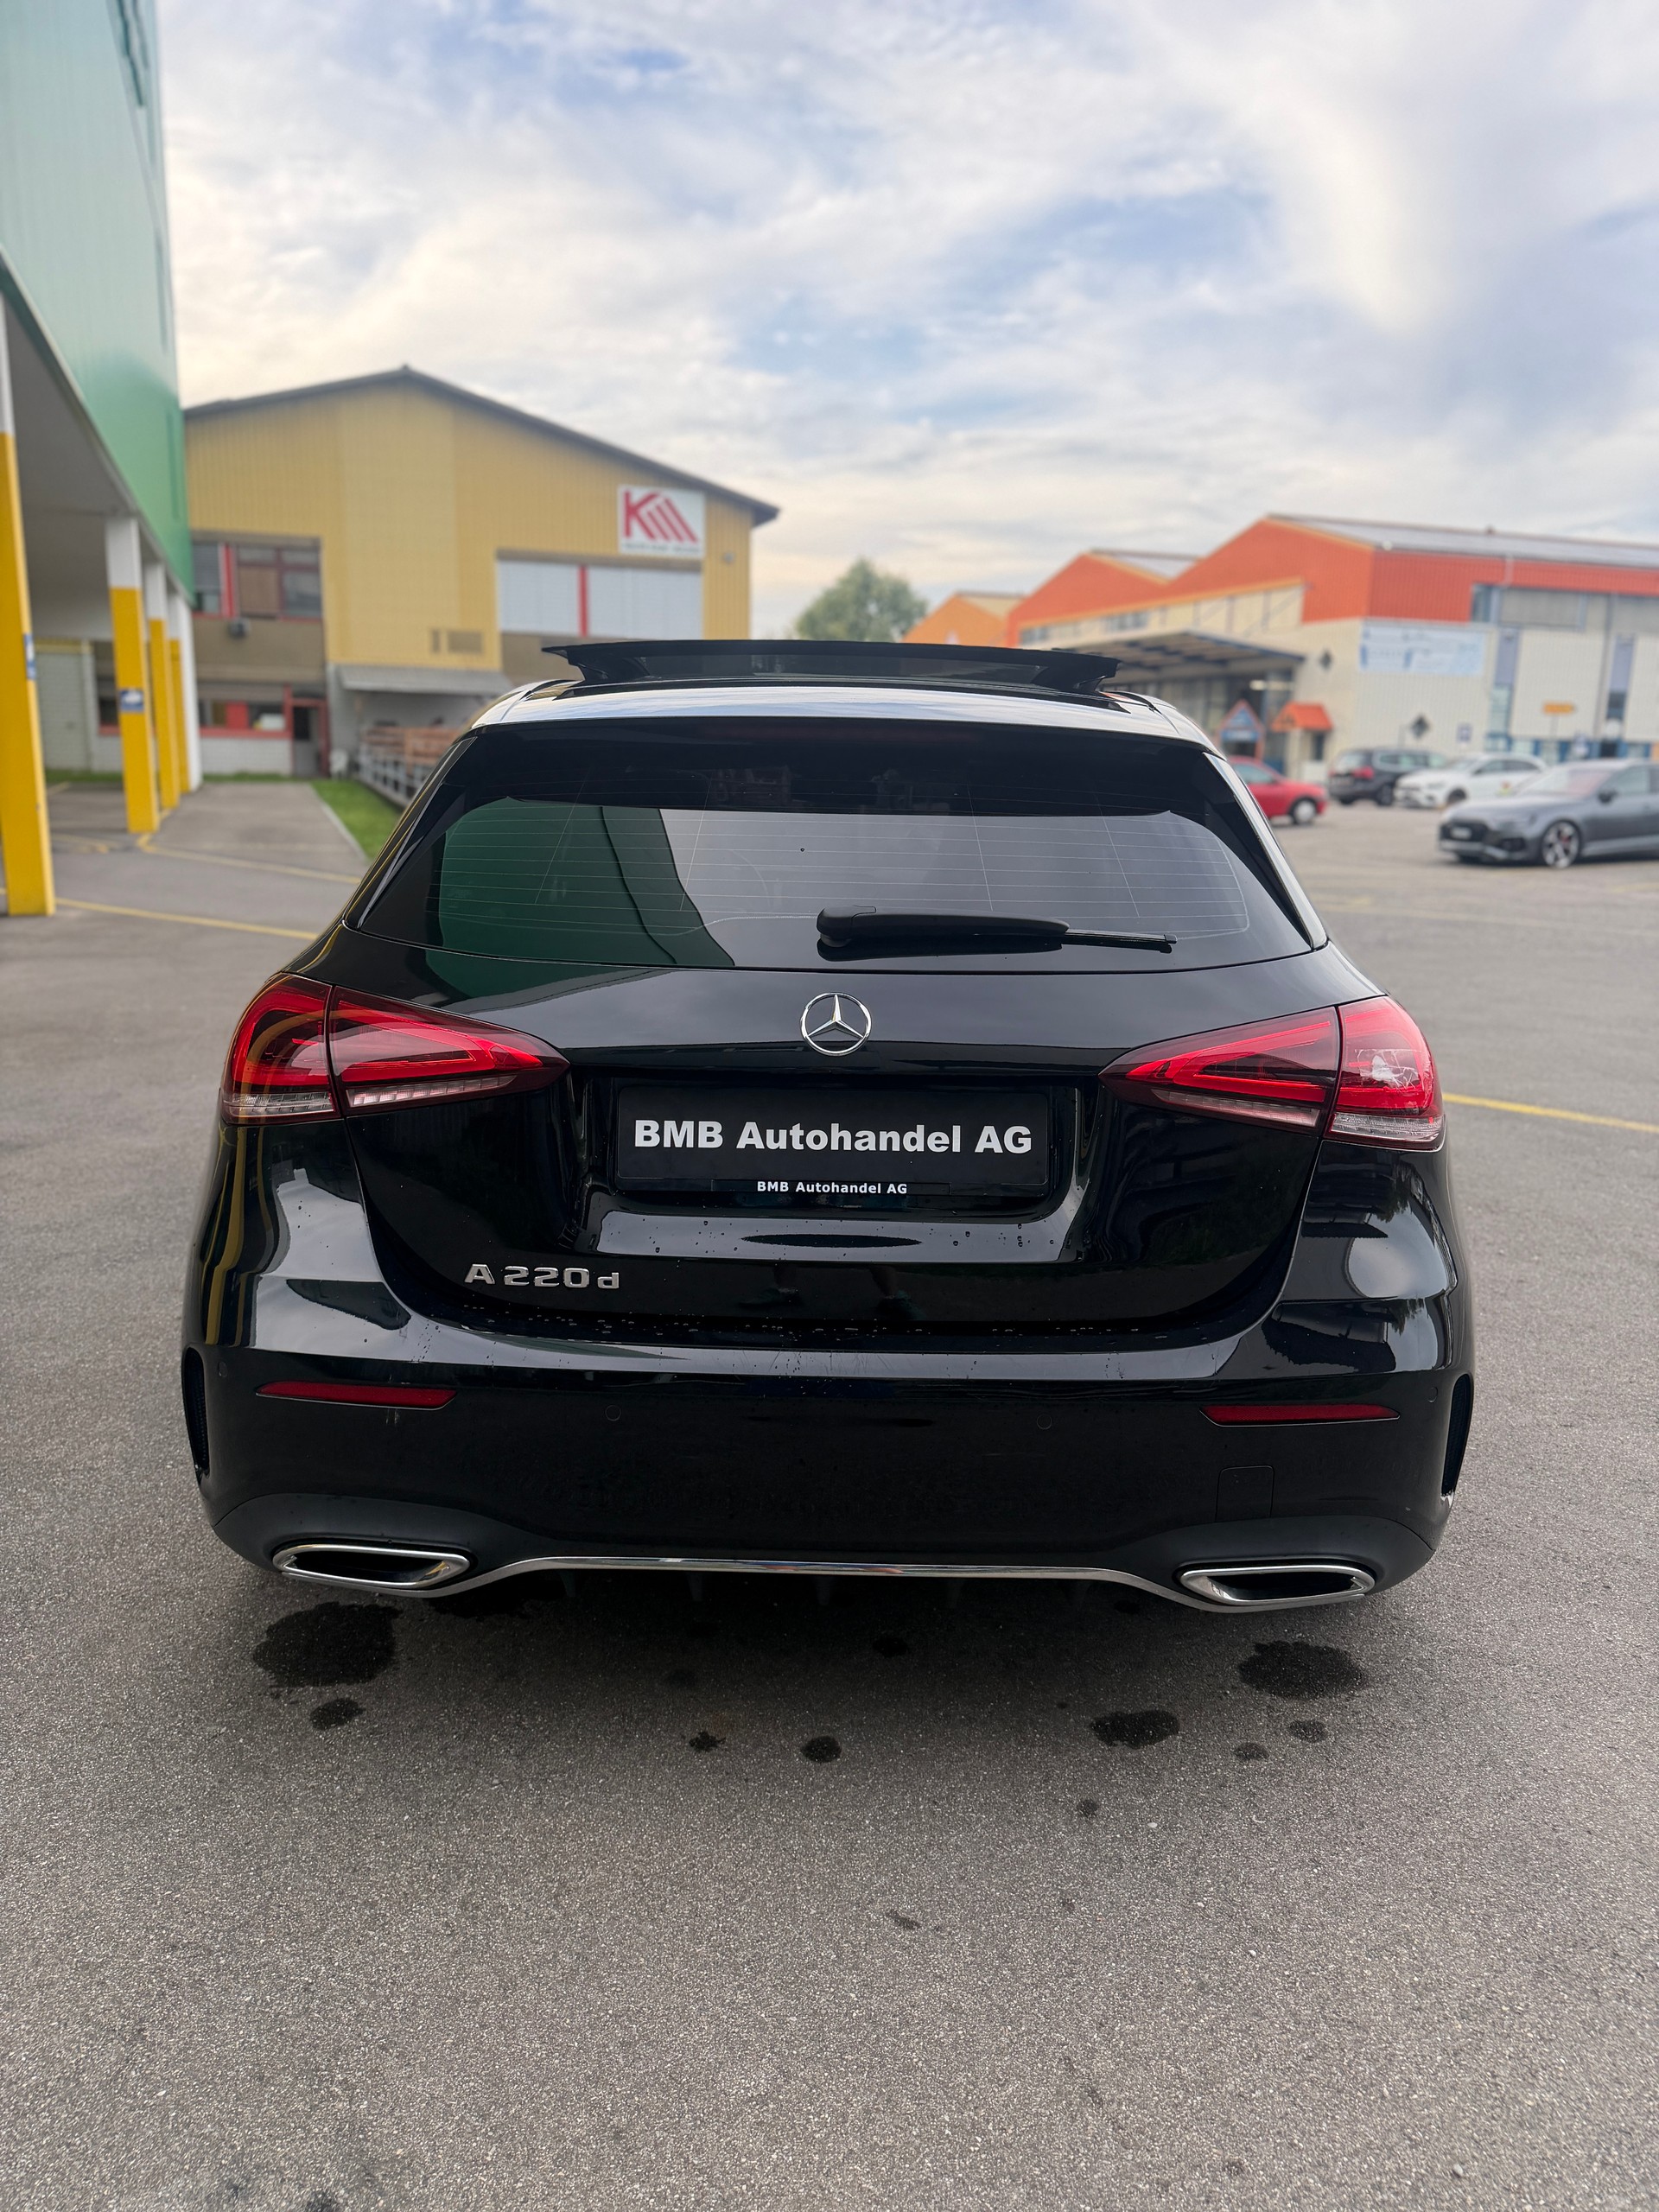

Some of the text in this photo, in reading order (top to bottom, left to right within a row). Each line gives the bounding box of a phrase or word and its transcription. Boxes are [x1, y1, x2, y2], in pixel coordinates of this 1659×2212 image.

[633, 1119, 1033, 1154] BMB Autohandel AG
[756, 1179, 908, 1195] BMB Autohandel AG
